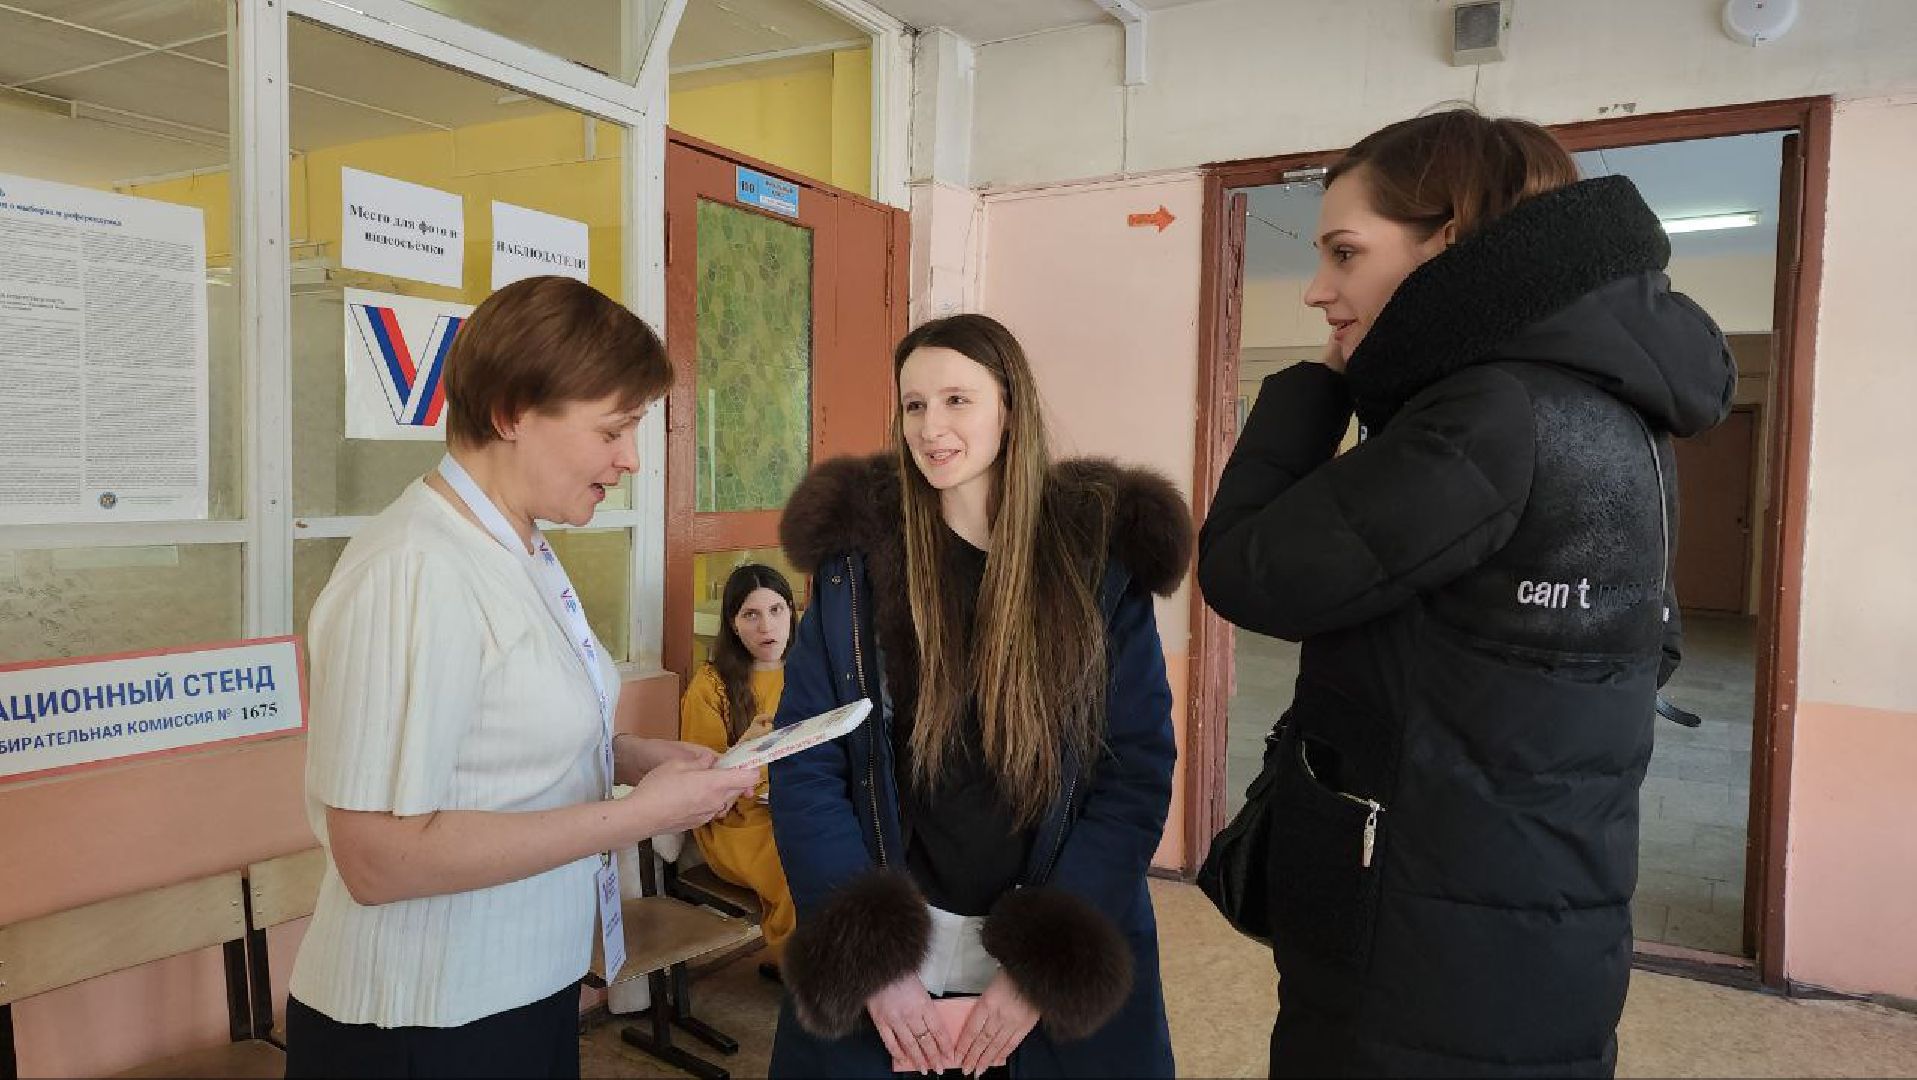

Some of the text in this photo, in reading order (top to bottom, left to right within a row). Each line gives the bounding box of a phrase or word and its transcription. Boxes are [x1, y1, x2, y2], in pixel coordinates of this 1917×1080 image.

[350, 204, 390, 224] Место
[393, 217, 415, 230] для
[418, 220, 448, 236] фото
[496, 240, 586, 270] НАБЛЮДАТЕЛИ
[183, 665, 276, 697] СТЕНД
[127, 710, 214, 736] КОМИССИЯ
[241, 702, 278, 721] 1675
